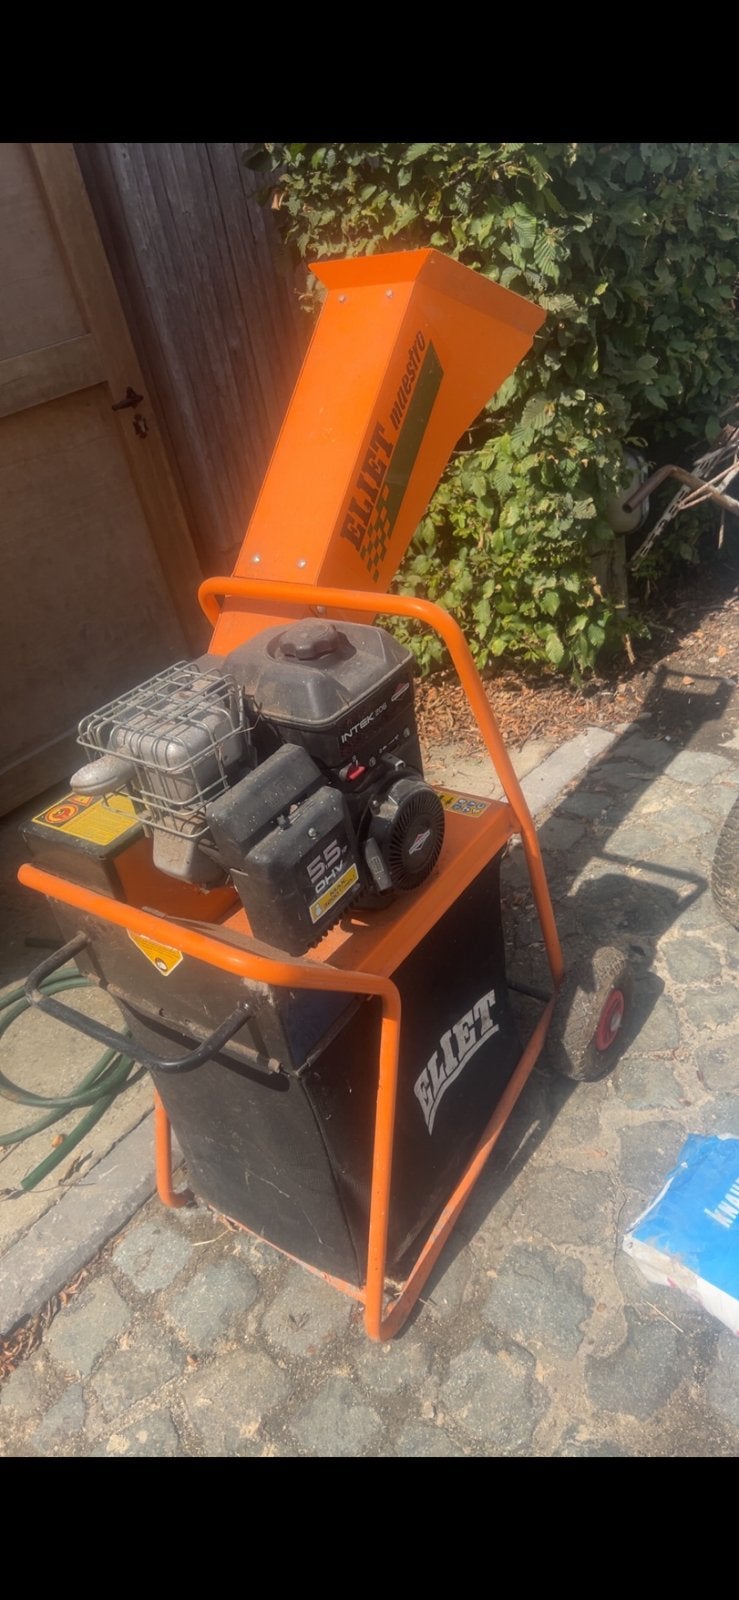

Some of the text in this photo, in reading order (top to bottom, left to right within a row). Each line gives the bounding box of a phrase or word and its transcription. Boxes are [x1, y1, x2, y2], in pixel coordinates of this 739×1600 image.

[340, 330, 426, 552] ELIET maestro
[341, 712, 374, 743] INTEK
[315, 860, 343, 893] OHV
[413, 989, 496, 1127] ELIET
[704, 1177, 739, 1228] KNA
